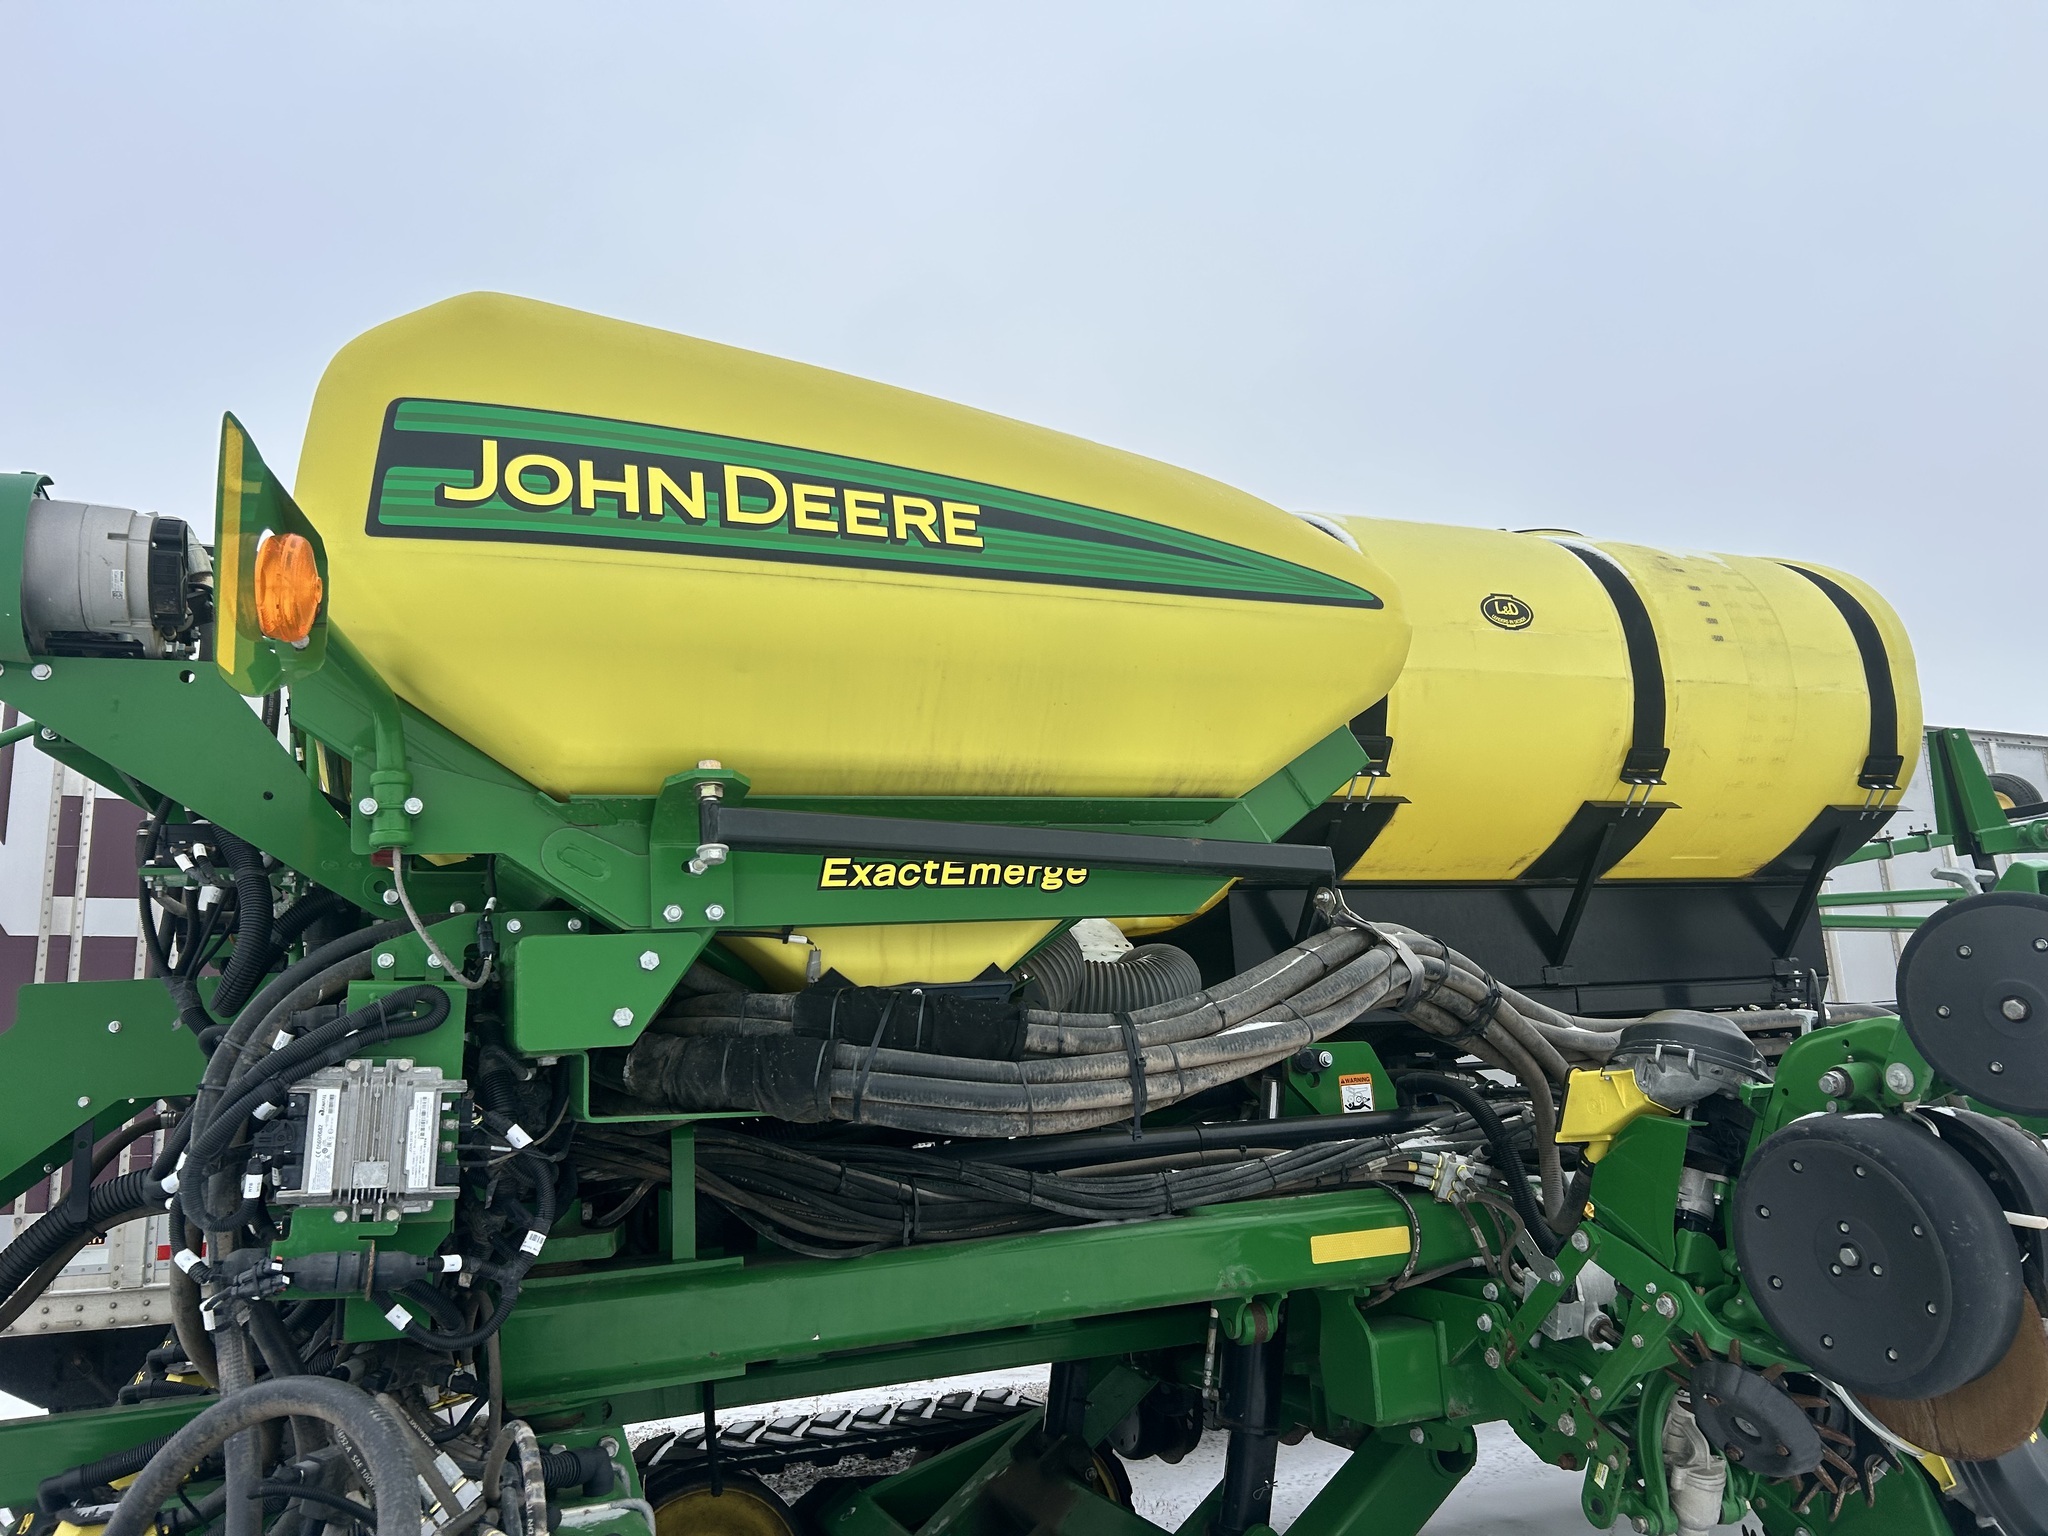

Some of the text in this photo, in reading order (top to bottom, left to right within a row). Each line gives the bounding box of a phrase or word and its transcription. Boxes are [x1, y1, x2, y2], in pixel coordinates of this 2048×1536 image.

[443, 438, 985, 548] JOHN DEERE
[1494, 600, 1519, 616] L&D
[820, 857, 1088, 890] ExactEmerge
[351, 1454, 364, 1469] SAE
